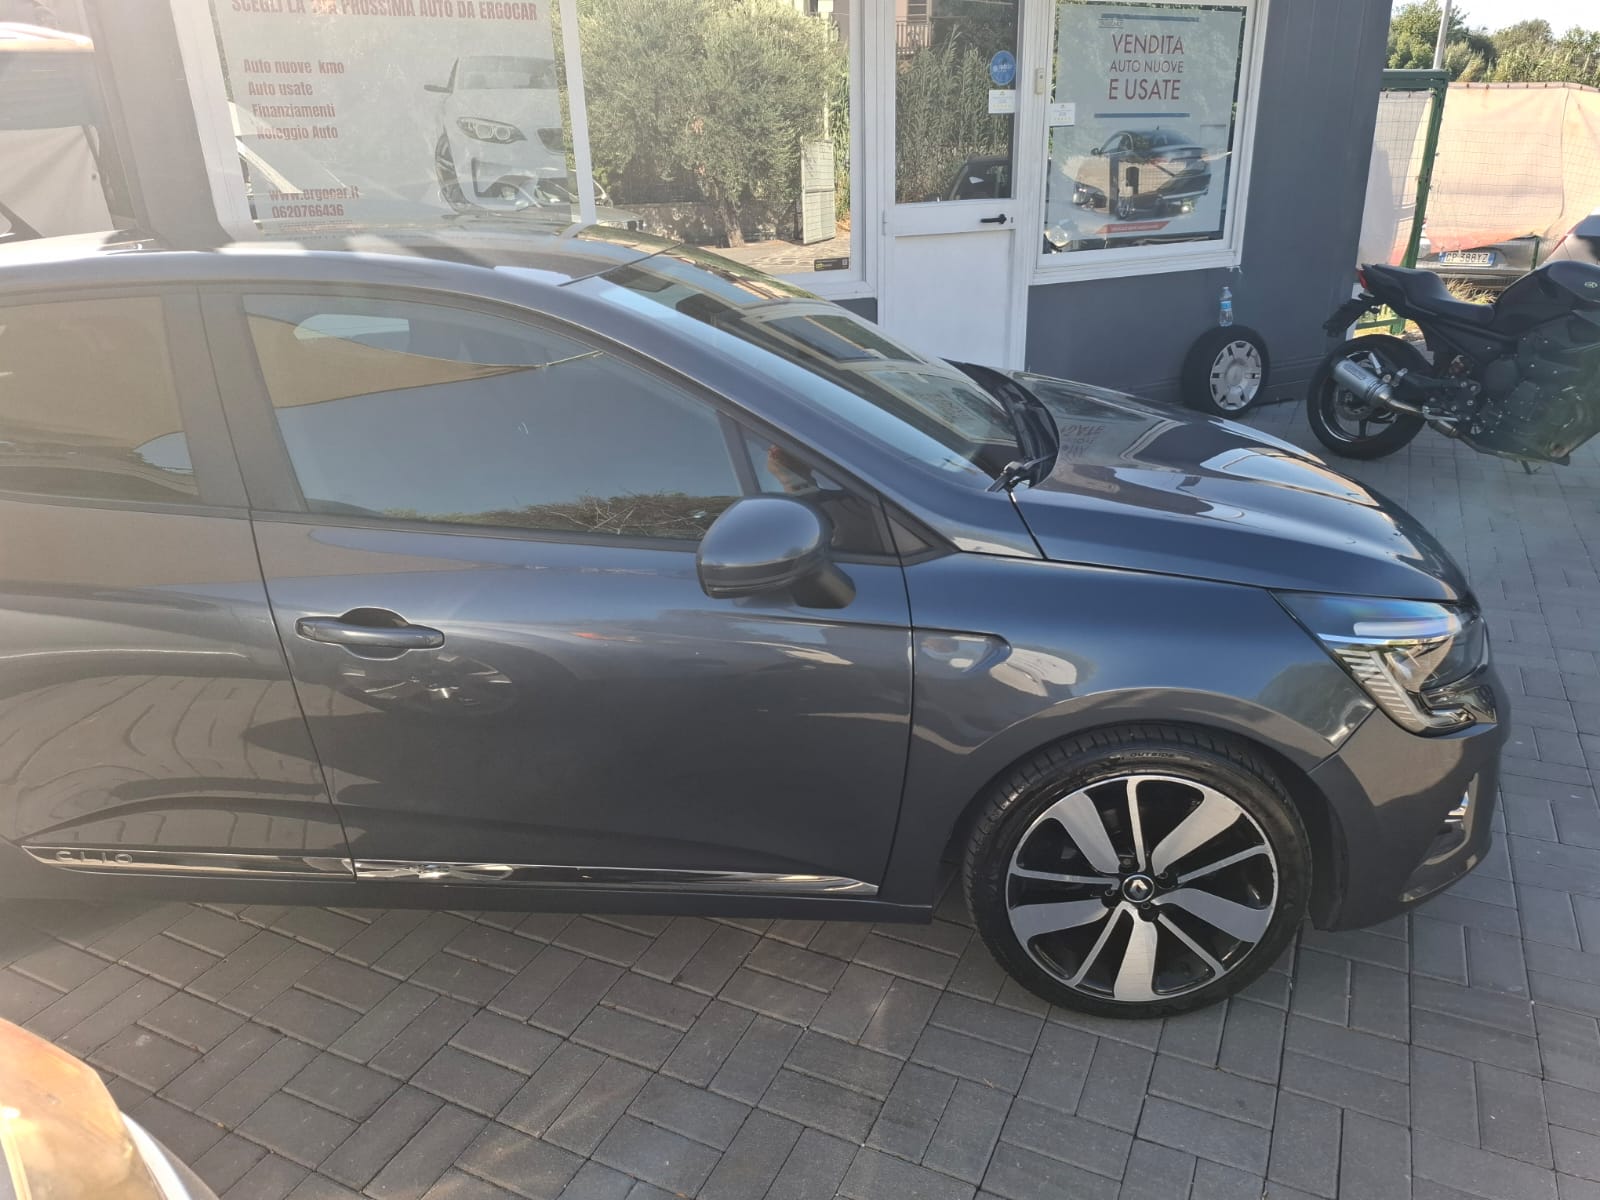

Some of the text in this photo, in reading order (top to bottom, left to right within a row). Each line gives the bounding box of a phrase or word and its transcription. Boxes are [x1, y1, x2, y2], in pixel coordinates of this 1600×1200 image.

[231, 0, 283, 13] SCEGLI
[286, 0, 305, 13] LA
[420, 0, 451, 18] AUTO
[457, 0, 477, 18] DA
[479, 2, 537, 21] ERGOCAR
[1112, 33, 1184, 54] VENDITA
[243, 59, 271, 74] Auto
[275, 61, 312, 74] nuove
[1109, 60, 1184, 73] AUTO NUOVE
[248, 81, 314, 96] Auto usate
[1109, 78, 1181, 100] E USATE
[252, 103, 336, 118] Finanziamenti
[256, 125, 338, 141] Noleggio Auto
[271, 203, 345, 219] 0620766436
[56, 850, 133, 865] CLIO
